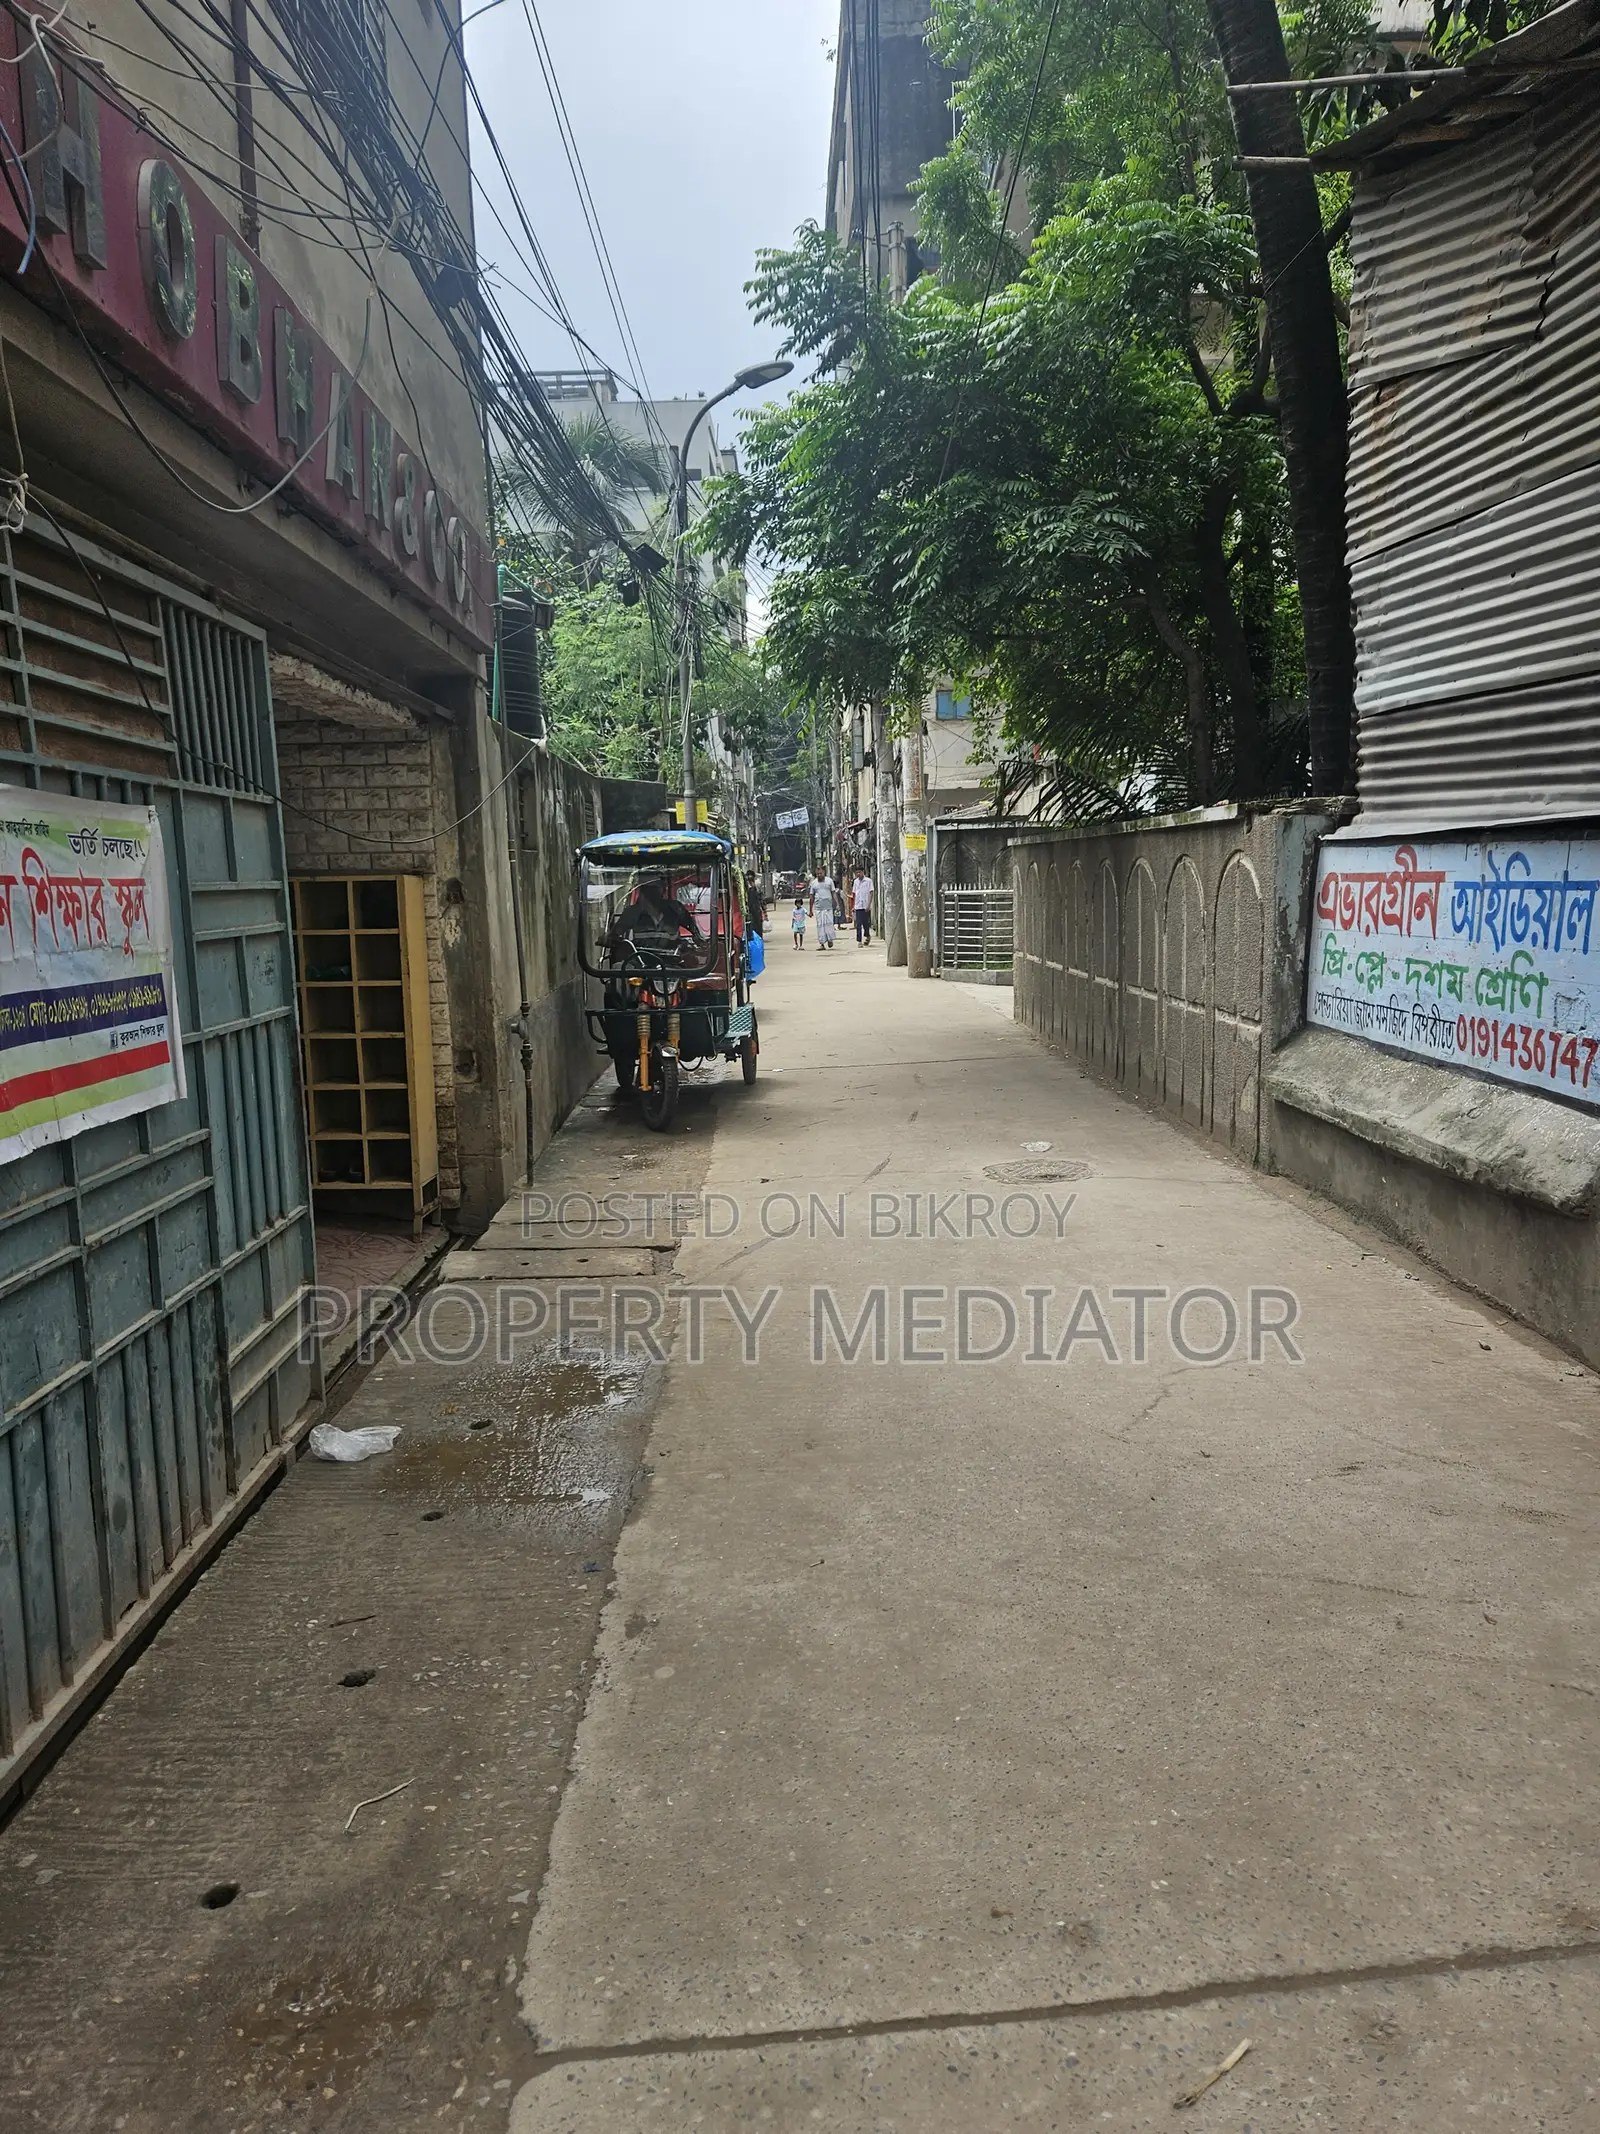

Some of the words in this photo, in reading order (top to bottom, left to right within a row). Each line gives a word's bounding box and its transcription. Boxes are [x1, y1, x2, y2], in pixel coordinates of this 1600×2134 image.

[67, 828, 99, 857] ভর্তি
[102, 837, 146, 862] চলছে!!
[21, 847, 109, 949] শিক্ষার
[107, 878, 150, 961] স্কুল
[1317, 844, 1447, 941] এভারগ্রীন
[1451, 850, 1600, 955] আইডিয়াল
[1405, 957, 1470, 1003] দশম
[1475, 949, 1549, 1018] শ্রেণি
[1456, 1014, 1599, 1089] 0191436747
